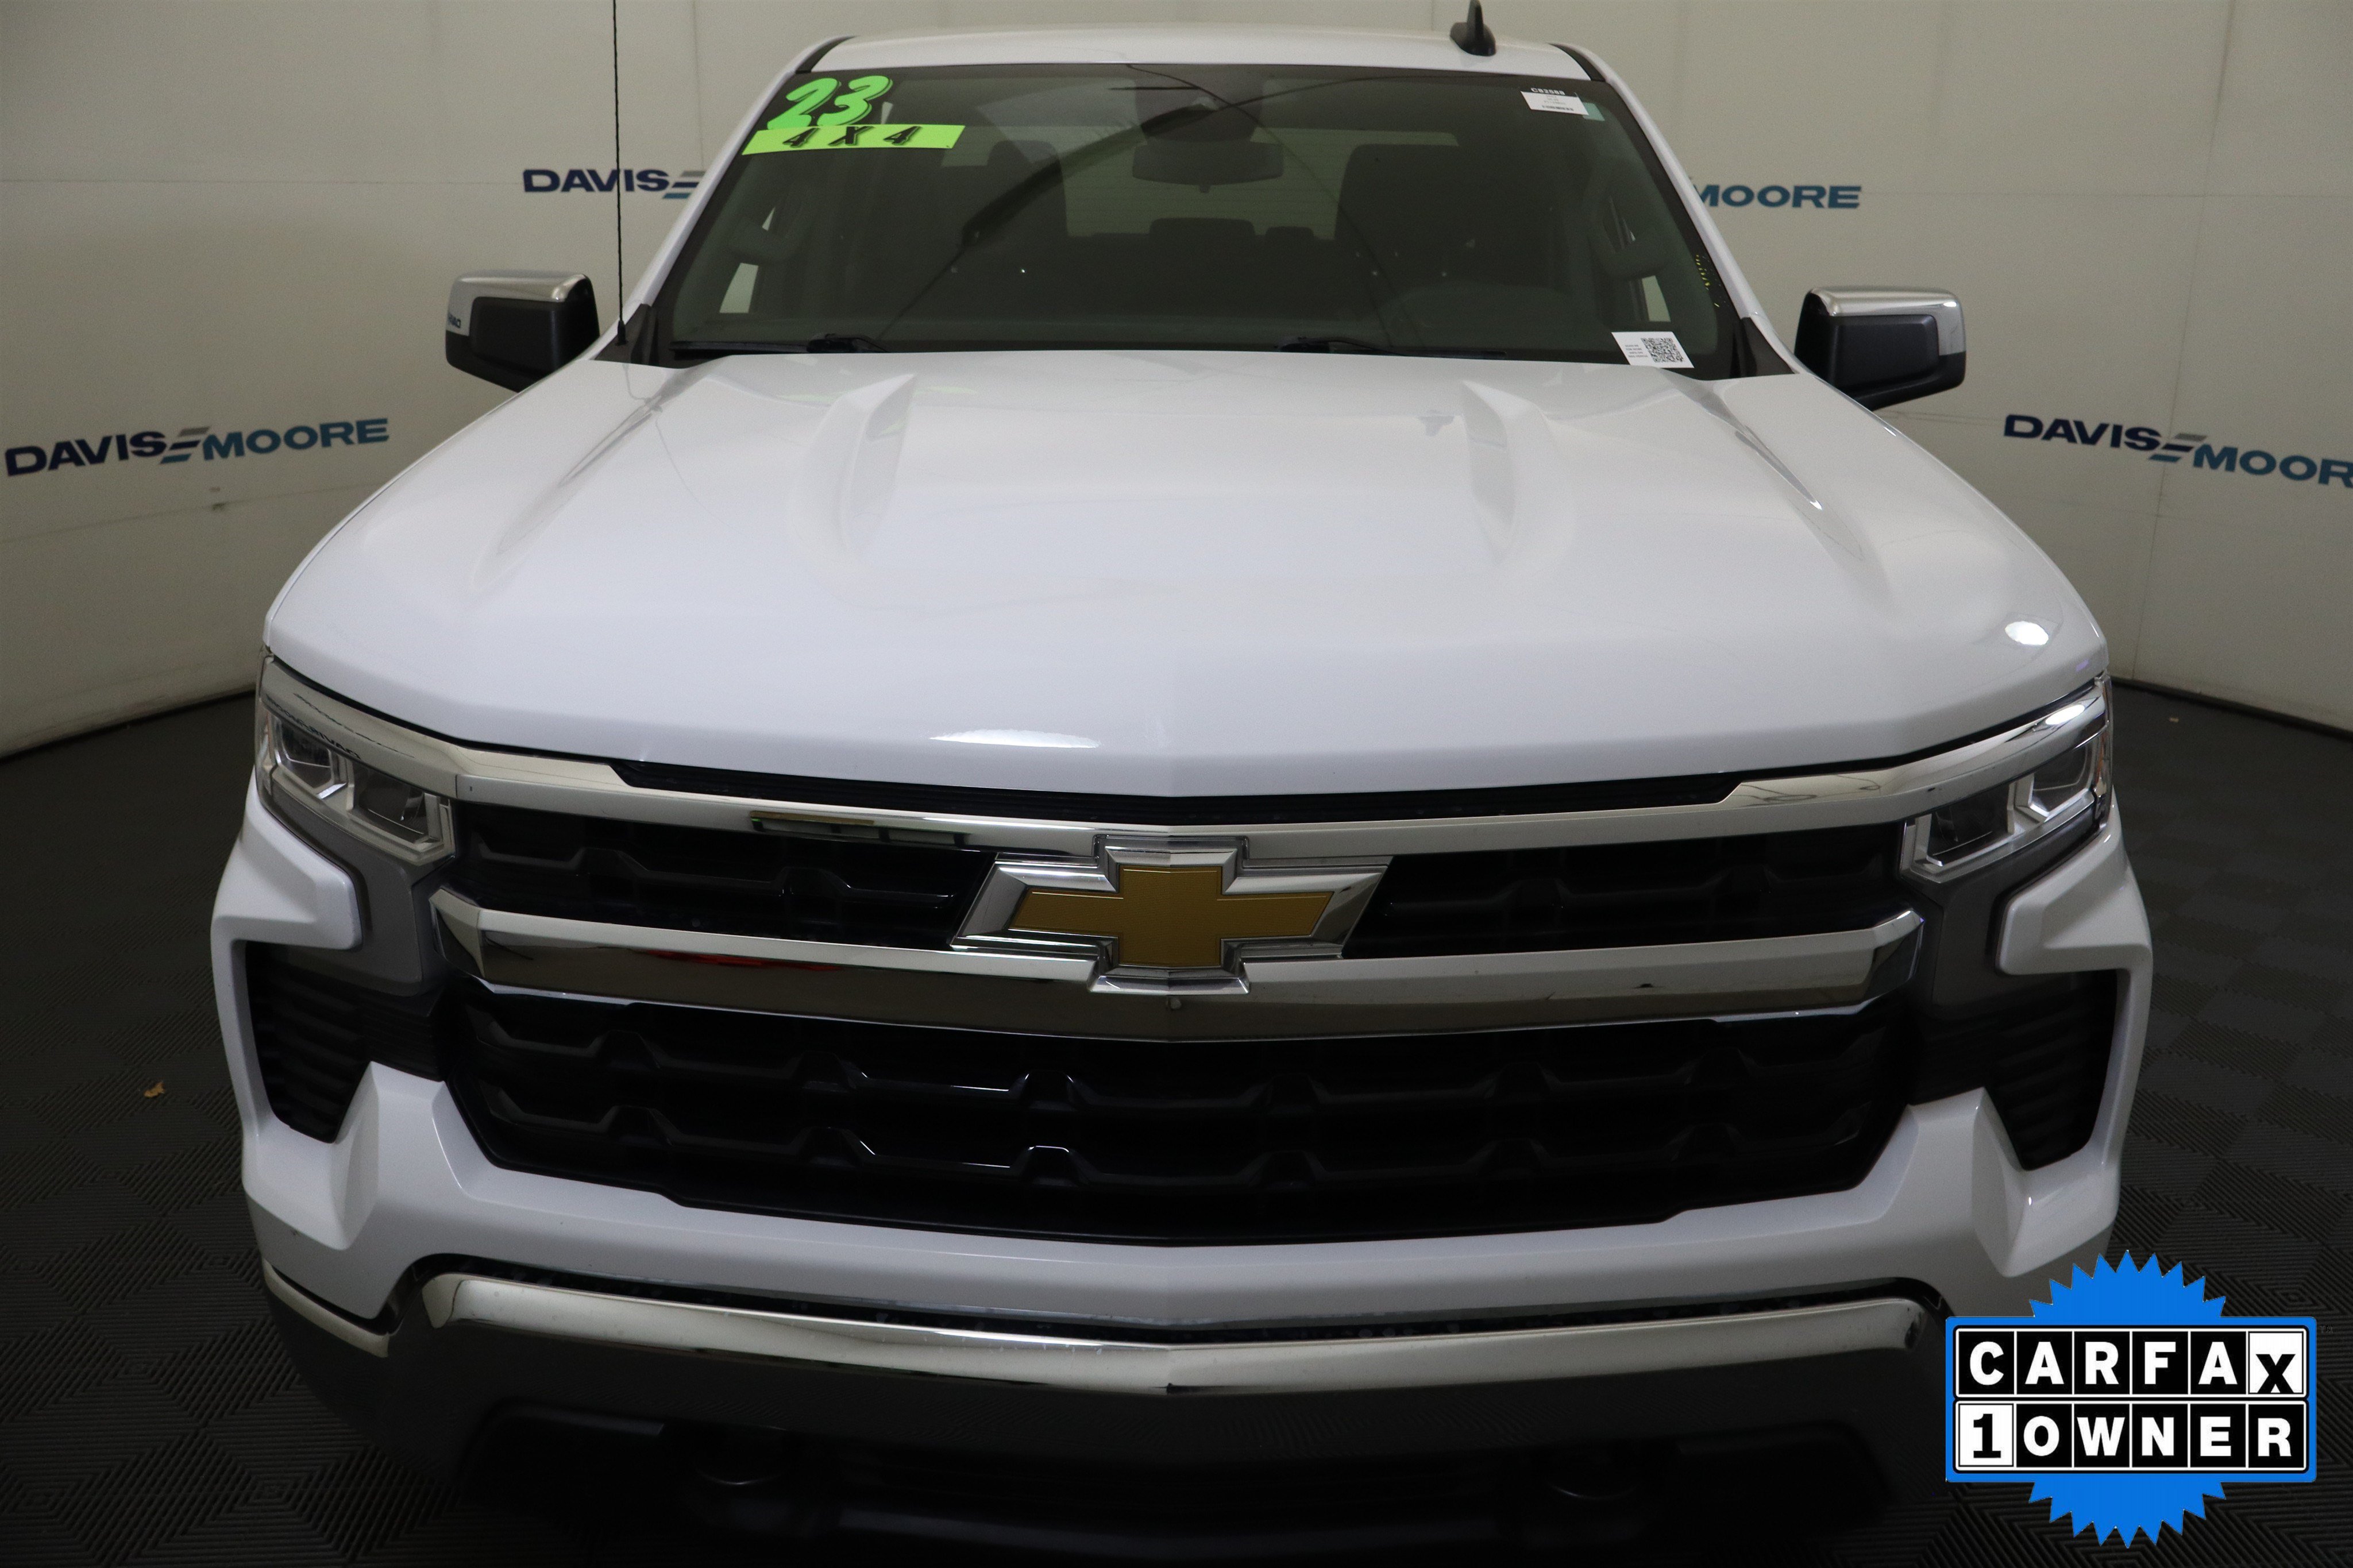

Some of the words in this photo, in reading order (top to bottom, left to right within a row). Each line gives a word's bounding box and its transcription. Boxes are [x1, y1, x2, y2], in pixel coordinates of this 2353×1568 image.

[767, 75, 893, 130] 23
[522, 169, 670, 193] DAVIS
[5, 431, 168, 477] DAVIS
[202, 418, 389, 461] MOORE
[2003, 414, 2162, 452] DAVIS
